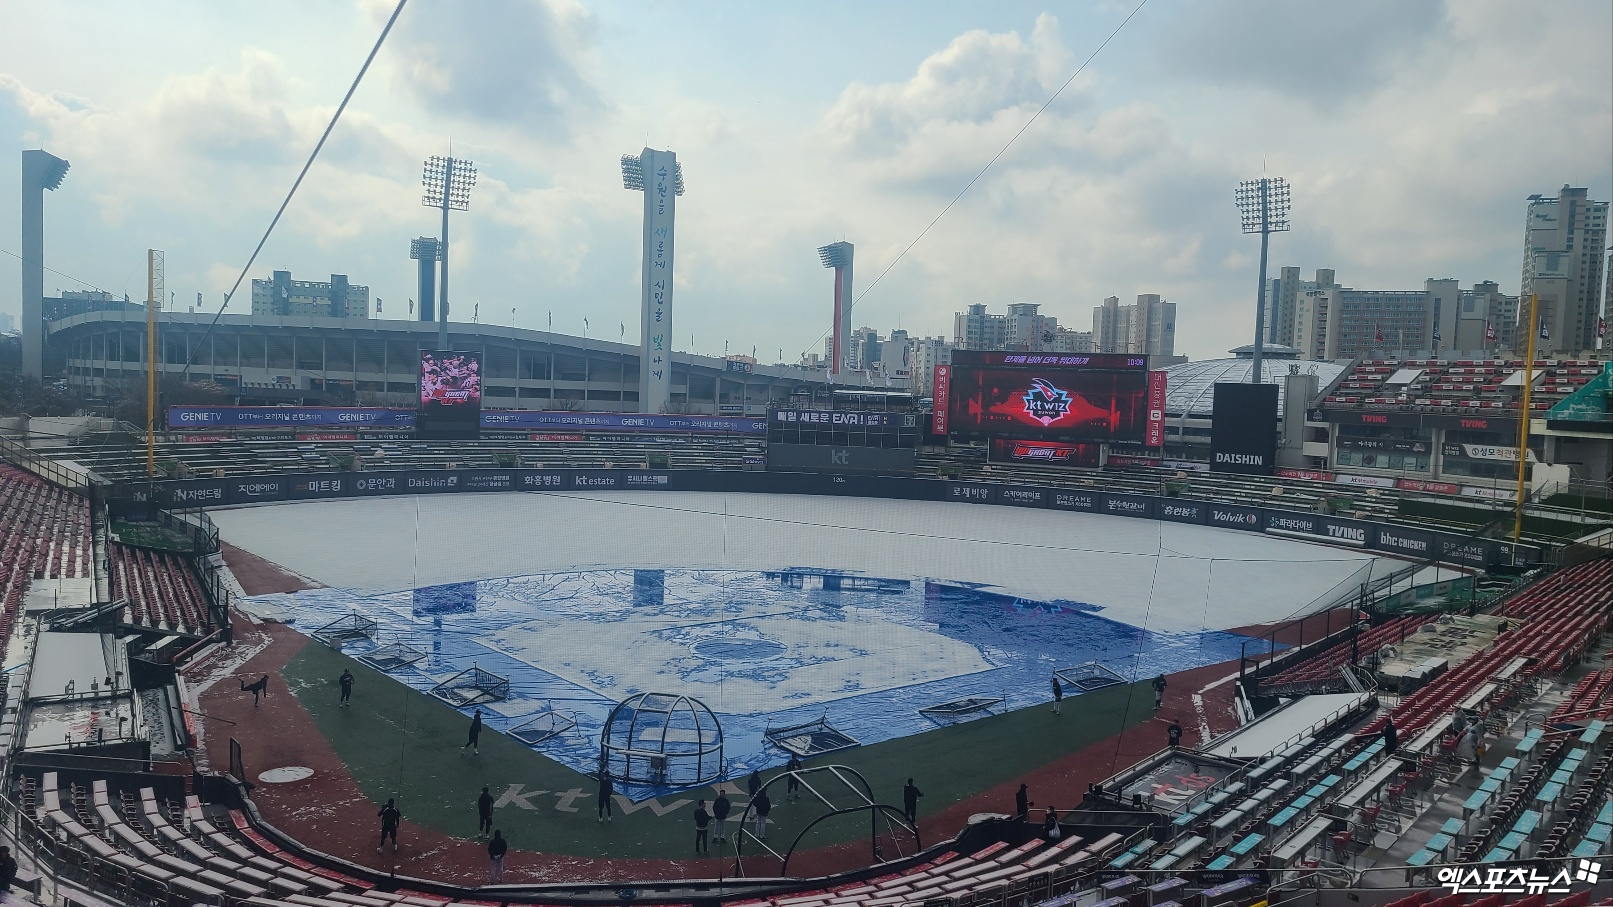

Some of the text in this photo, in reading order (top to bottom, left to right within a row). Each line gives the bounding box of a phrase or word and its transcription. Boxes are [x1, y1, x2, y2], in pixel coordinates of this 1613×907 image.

[656, 166, 667, 216] 수원을
[654, 226, 667, 268] 새롭게
[652, 334, 664, 380] 빛나게
[1030, 400, 1041, 410] kt
[778, 412, 796, 422] 매일
[800, 413, 829, 423] 새로운
[1362, 415, 1387, 423] TVING
[1461, 420, 1487, 429] TVING
[832, 450, 849, 464] kt
[1216, 452, 1262, 466] DAISHIN
[309, 480, 341, 492] 마트킹
[367, 478, 396, 490] 문안과
[409, 478, 446, 487] Daishin
[524, 475, 561, 485] 화홍병원
[576, 476, 587, 485] kt
[188, 489, 222, 500] 자연드림
[953, 487, 988, 499] 로제비앙
[1004, 490, 1041, 500] 스카이라이프
[1213, 511, 1244, 523] Volvik
[1279, 518, 1312, 531] 파라다이브
[1327, 525, 1364, 540] TVING
[1381, 532, 1427, 551] bhc CHICKEN
[494, 784, 593, 812] kt
